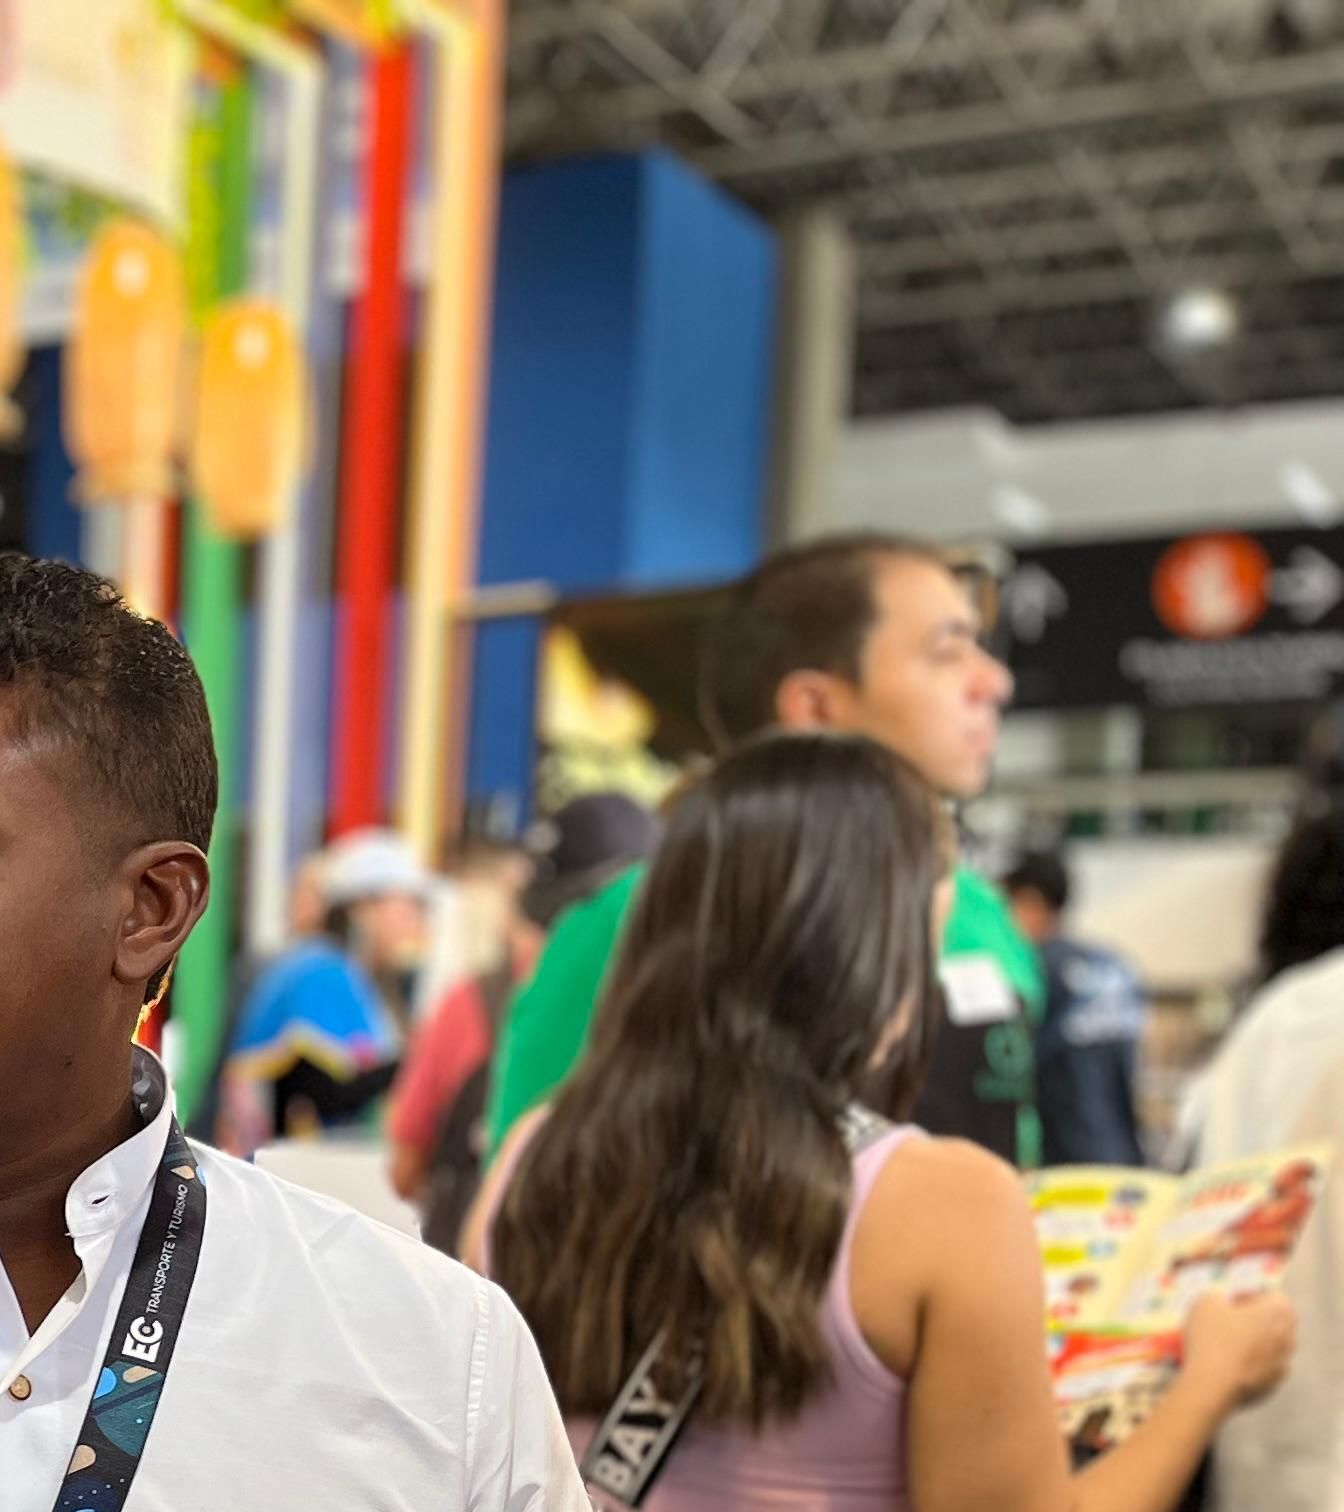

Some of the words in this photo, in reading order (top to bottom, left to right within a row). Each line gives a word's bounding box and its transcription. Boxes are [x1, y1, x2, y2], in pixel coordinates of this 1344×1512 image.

[170, 1184, 188, 1231] TURISMO
[167, 1230, 177, 1239] Y
[146, 1240, 175, 1314] TRANSPORTE
